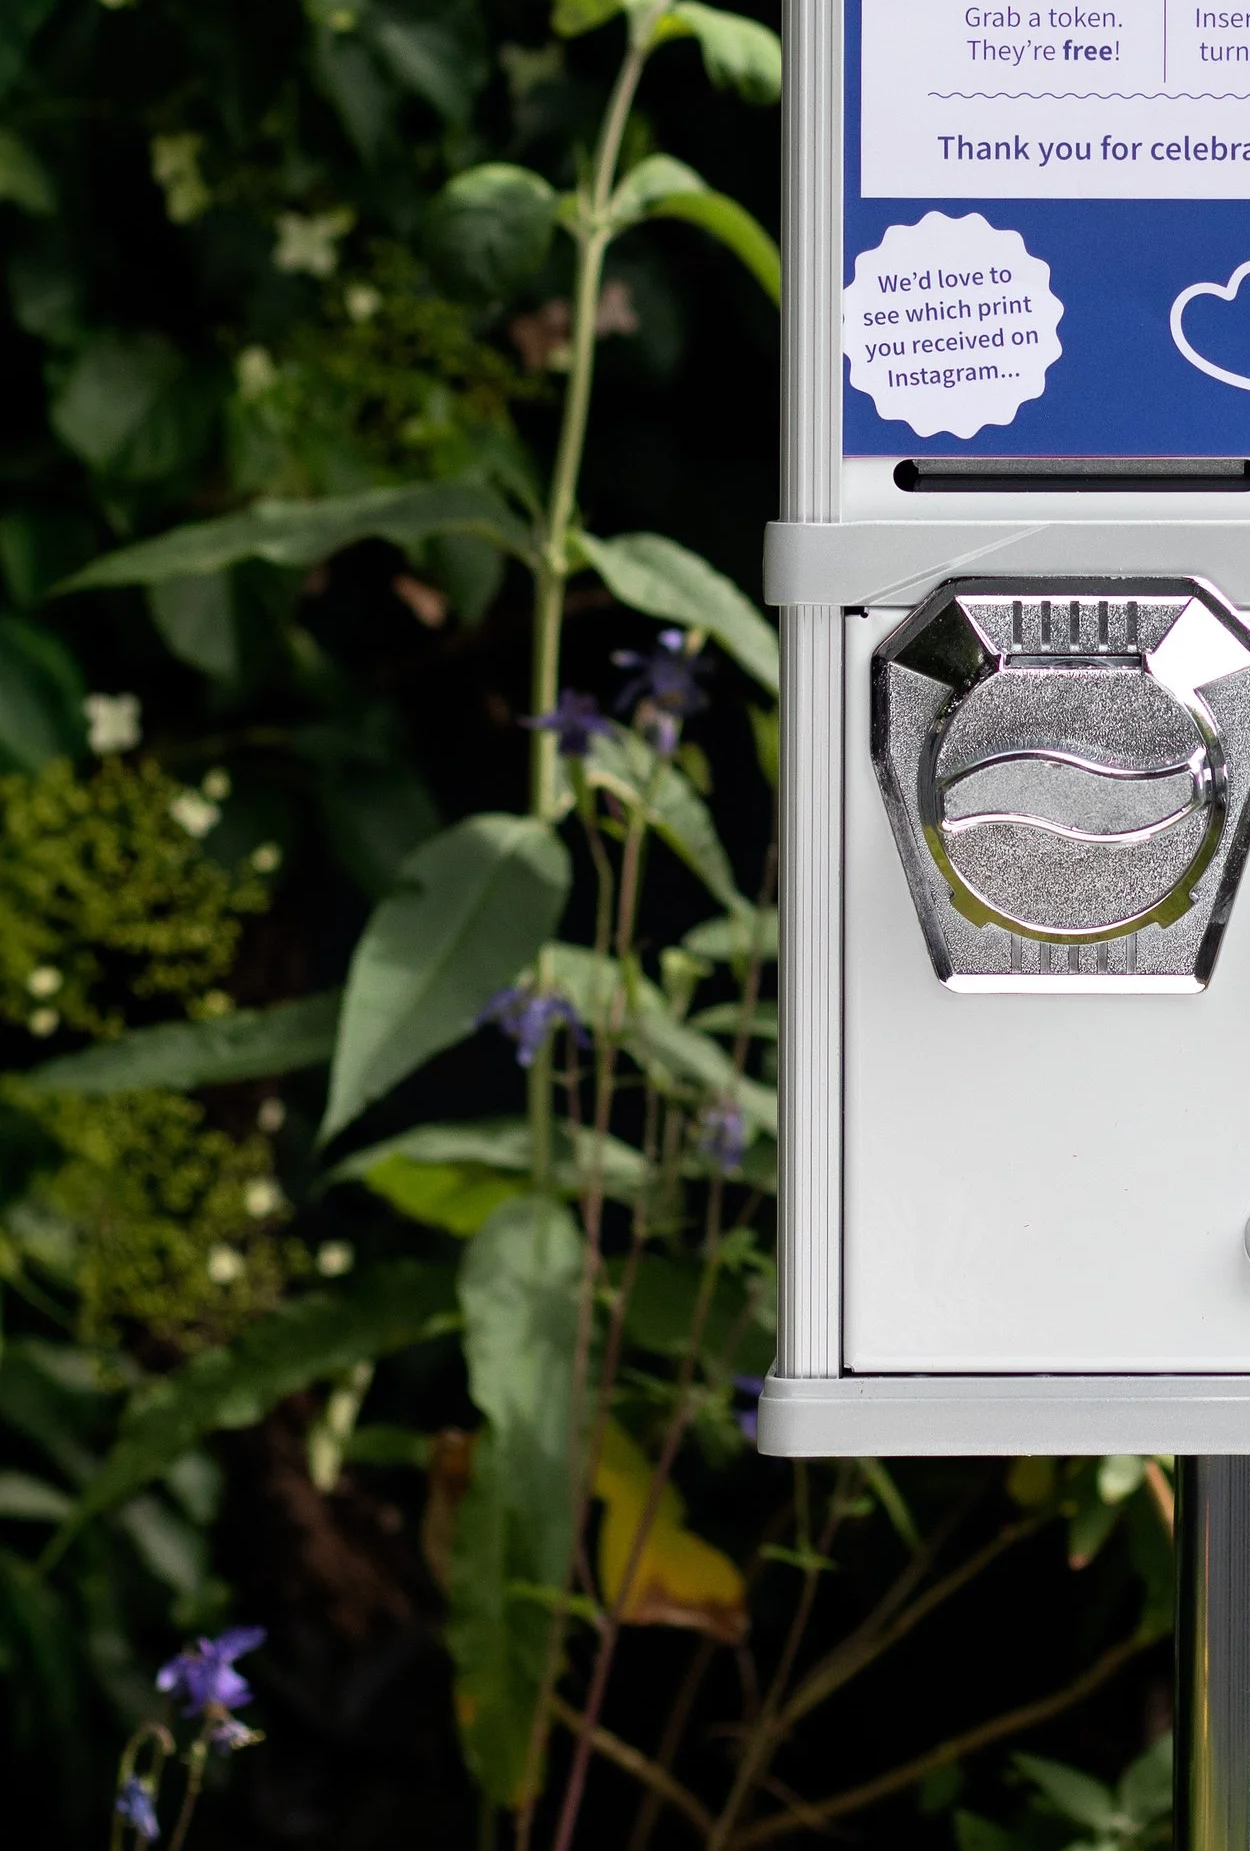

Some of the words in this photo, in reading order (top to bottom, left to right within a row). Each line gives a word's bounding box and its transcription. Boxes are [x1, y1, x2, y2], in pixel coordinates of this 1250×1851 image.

[965, 5, 1021, 28] Grab
[1028, 12, 1041, 28] a
[1048, 5, 1123, 28] token.
[966, 38, 1056, 67] They’re
[1062, 39, 1120, 61] free!
[1199, 42, 1249, 62] turn
[937, 134, 1030, 161] Thank
[1037, 141, 1091, 167] you
[1100, 134, 1143, 161] for
[877, 270, 932, 294] We’d
[938, 269, 984, 289] love
[989, 266, 1012, 285] to
[863, 310, 900, 327] see
[905, 299, 972, 323] which
[978, 295, 1033, 322] print
[864, 341, 905, 364] you
[912, 327, 1005, 354] received
[1011, 330, 1039, 346] on
[888, 365, 1020, 389] Instagram...
